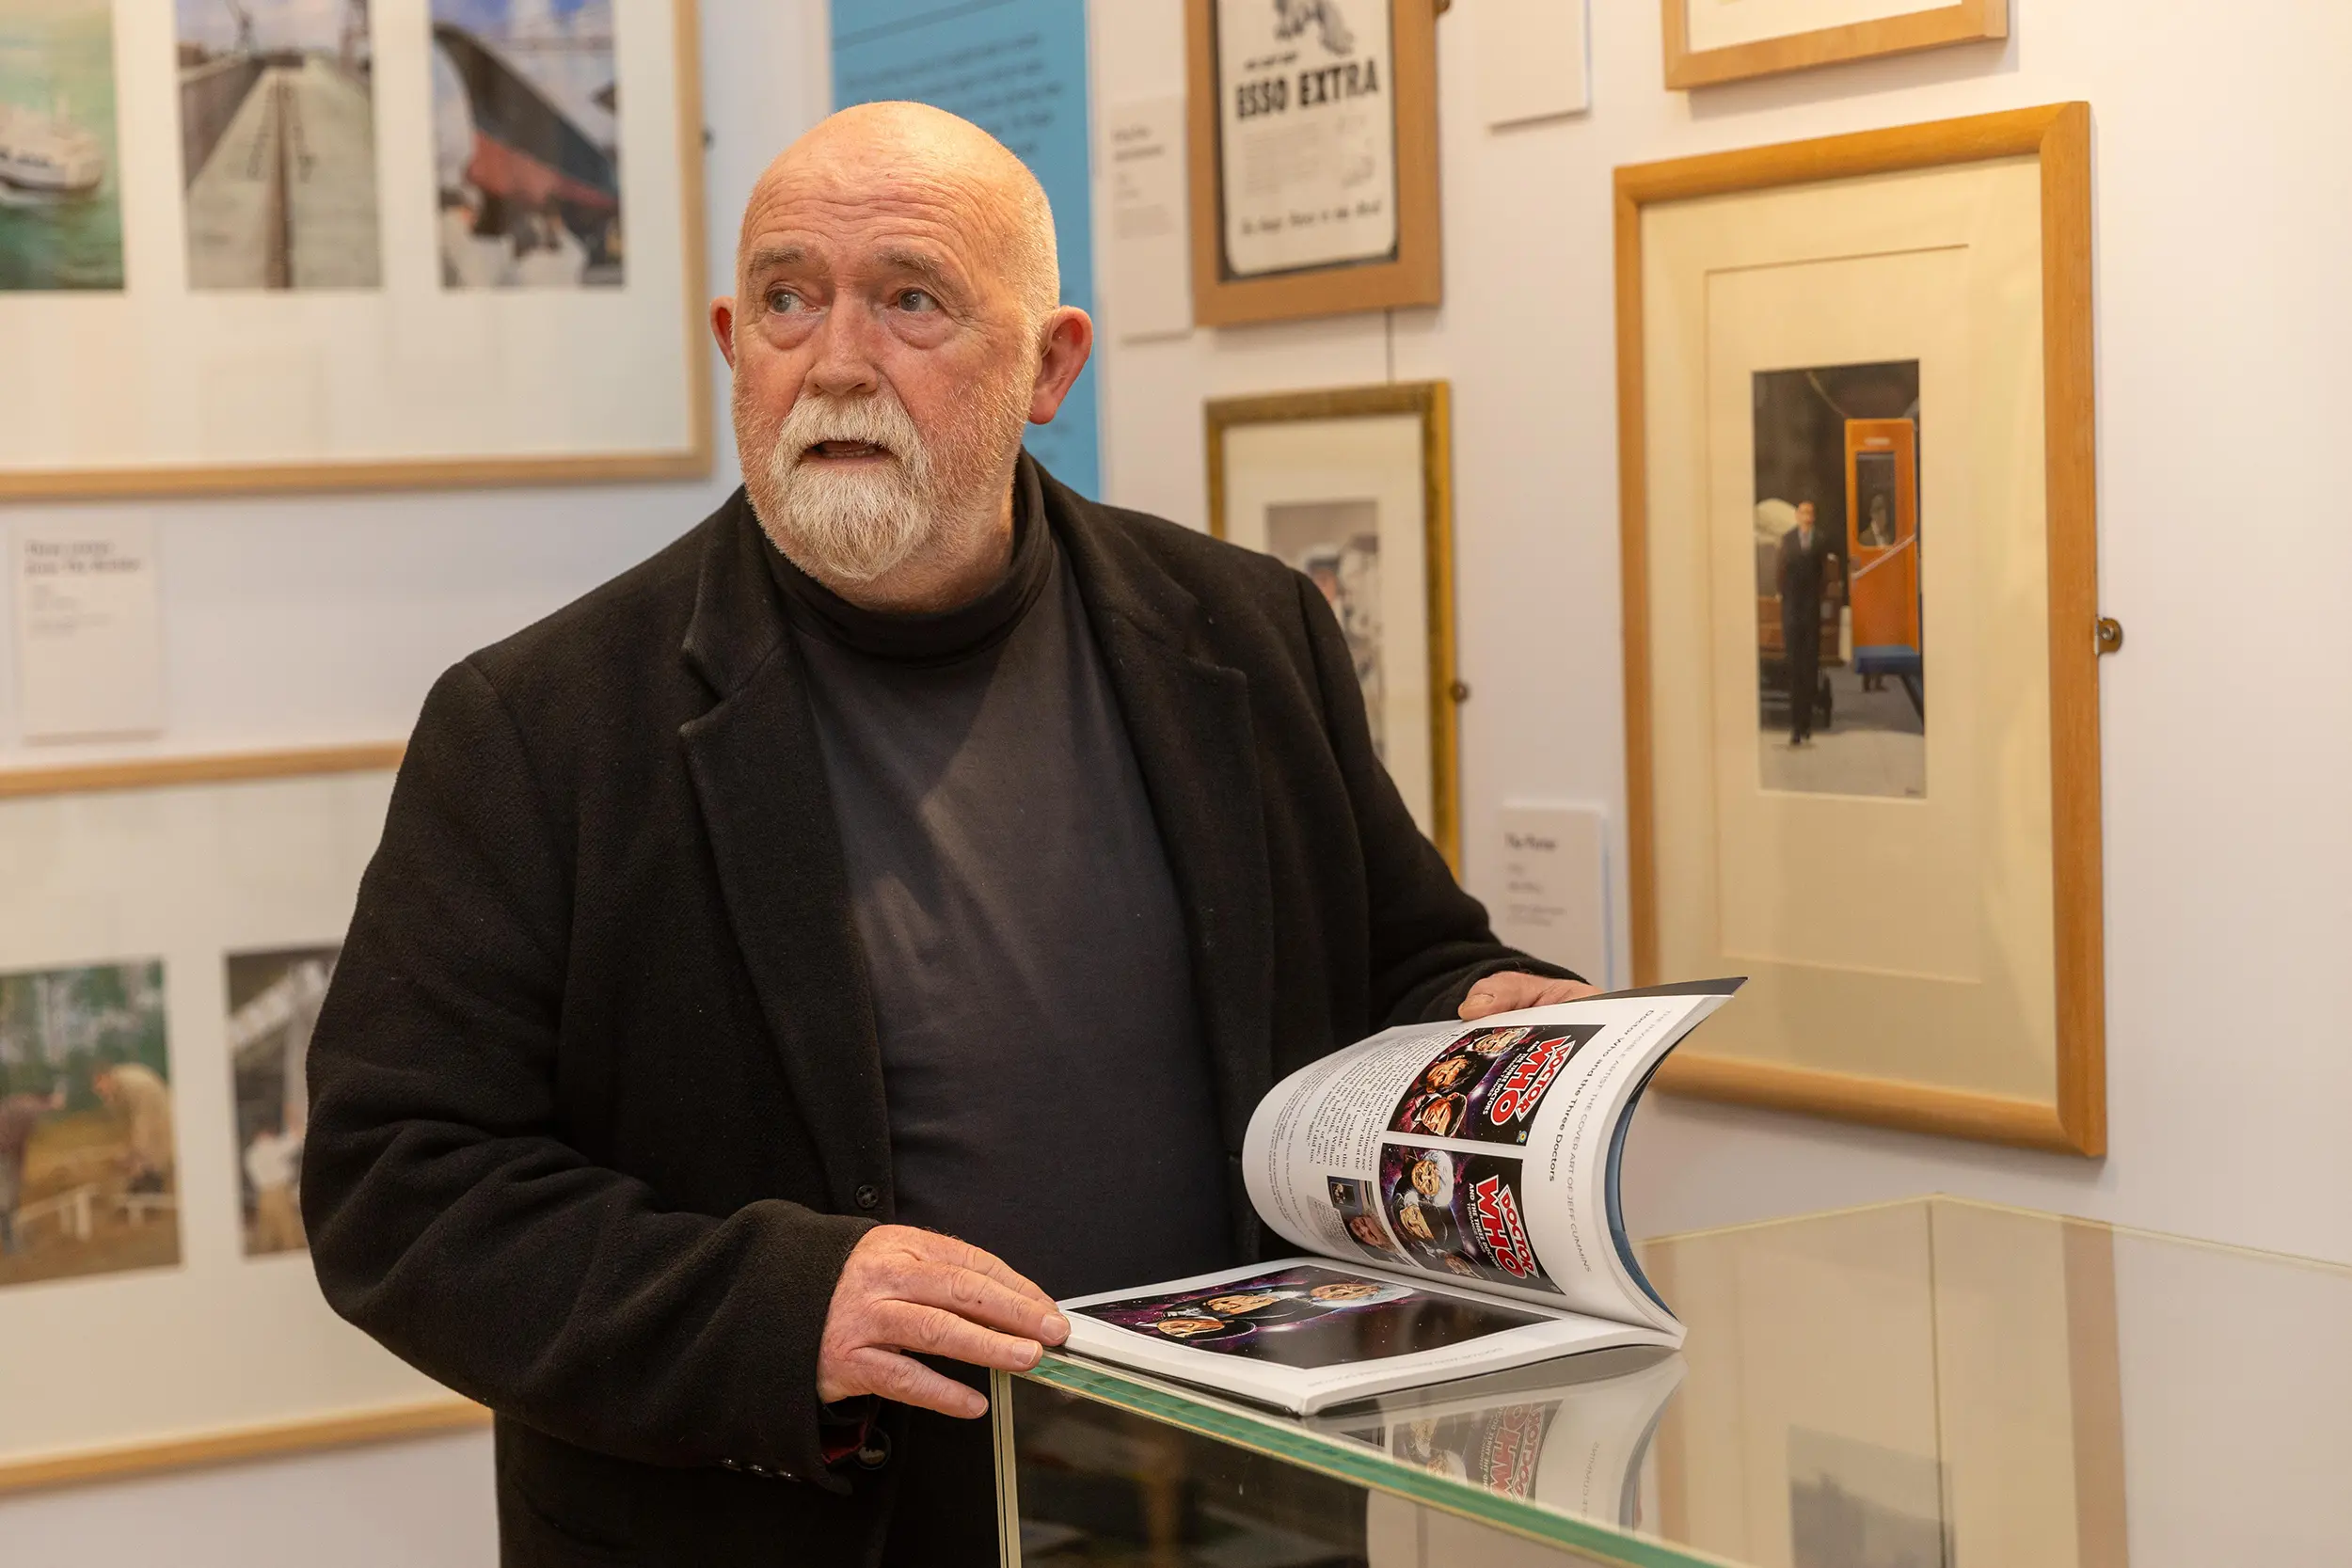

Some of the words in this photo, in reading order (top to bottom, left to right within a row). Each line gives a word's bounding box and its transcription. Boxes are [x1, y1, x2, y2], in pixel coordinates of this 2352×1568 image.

[1236, 75, 1287, 120] ESSO
[1298, 57, 1379, 106] EXTRA
[1624, 1009, 1654, 1036] Doctor
[1517, 1053, 1529, 1063] THE
[1603, 1037, 1625, 1057] Who
[1490, 1035, 1571, 1125] WHO
[1500, 1064, 1518, 1083] THREE
[1518, 1045, 1570, 1113] DOCTOR
[1587, 1059, 1602, 1077] and
[1340, 1087, 1349, 1097] the
[1352, 1089, 1365, 1107] down
[1370, 1083, 1378, 1091] the
[1574, 1078, 1589, 1096] the
[1313, 1091, 1332, 1119] attention
[1328, 1095, 1337, 1105] the
[1330, 1100, 1341, 1112] hell
[1338, 1088, 1360, 1124] impression
[1359, 1093, 1370, 1108] scale
[1360, 1101, 1372, 1117] 2017.
[1372, 1092, 1384, 1108] time,
[1377, 1094, 1390, 1111] when
[1377, 1097, 1393, 1126] detailed.
[1483, 1084, 1503, 1115] DOCTORS
[1586, 1092, 1599, 1112] THE
[1316, 1106, 1328, 1128] series,
[1327, 1107, 1343, 1134] Thanks,
[1360, 1117, 1371, 1133] they
[1559, 1096, 1579, 1131] Three
[1320, 1131, 1326, 1139] of
[1335, 1125, 1341, 1133] of
[1338, 1113, 1351, 1148] alongside
[1345, 1114, 1358, 1141] worked
[1363, 1117, 1376, 1156] sometimes
[1573, 1114, 1588, 1150] COVER
[1329, 1136, 1338, 1166] William
[1334, 1154, 1340, 1167] my
[1549, 1133, 1564, 1181] Doctors
[1566, 1152, 1576, 1172] ART
[1566, 1177, 1574, 1193] OF
[1467, 1203, 1478, 1236] TERRANCE
[1566, 1195, 1576, 1221] JEFF
[1476, 1175, 1527, 1278] WHO
[1501, 1193, 1534, 1272] DOCTOR
[1474, 1218, 1485, 1241] THREE
[1483, 1242, 1502, 1270] DOCTORS
[1570, 1223, 1592, 1272] CUMMINS
